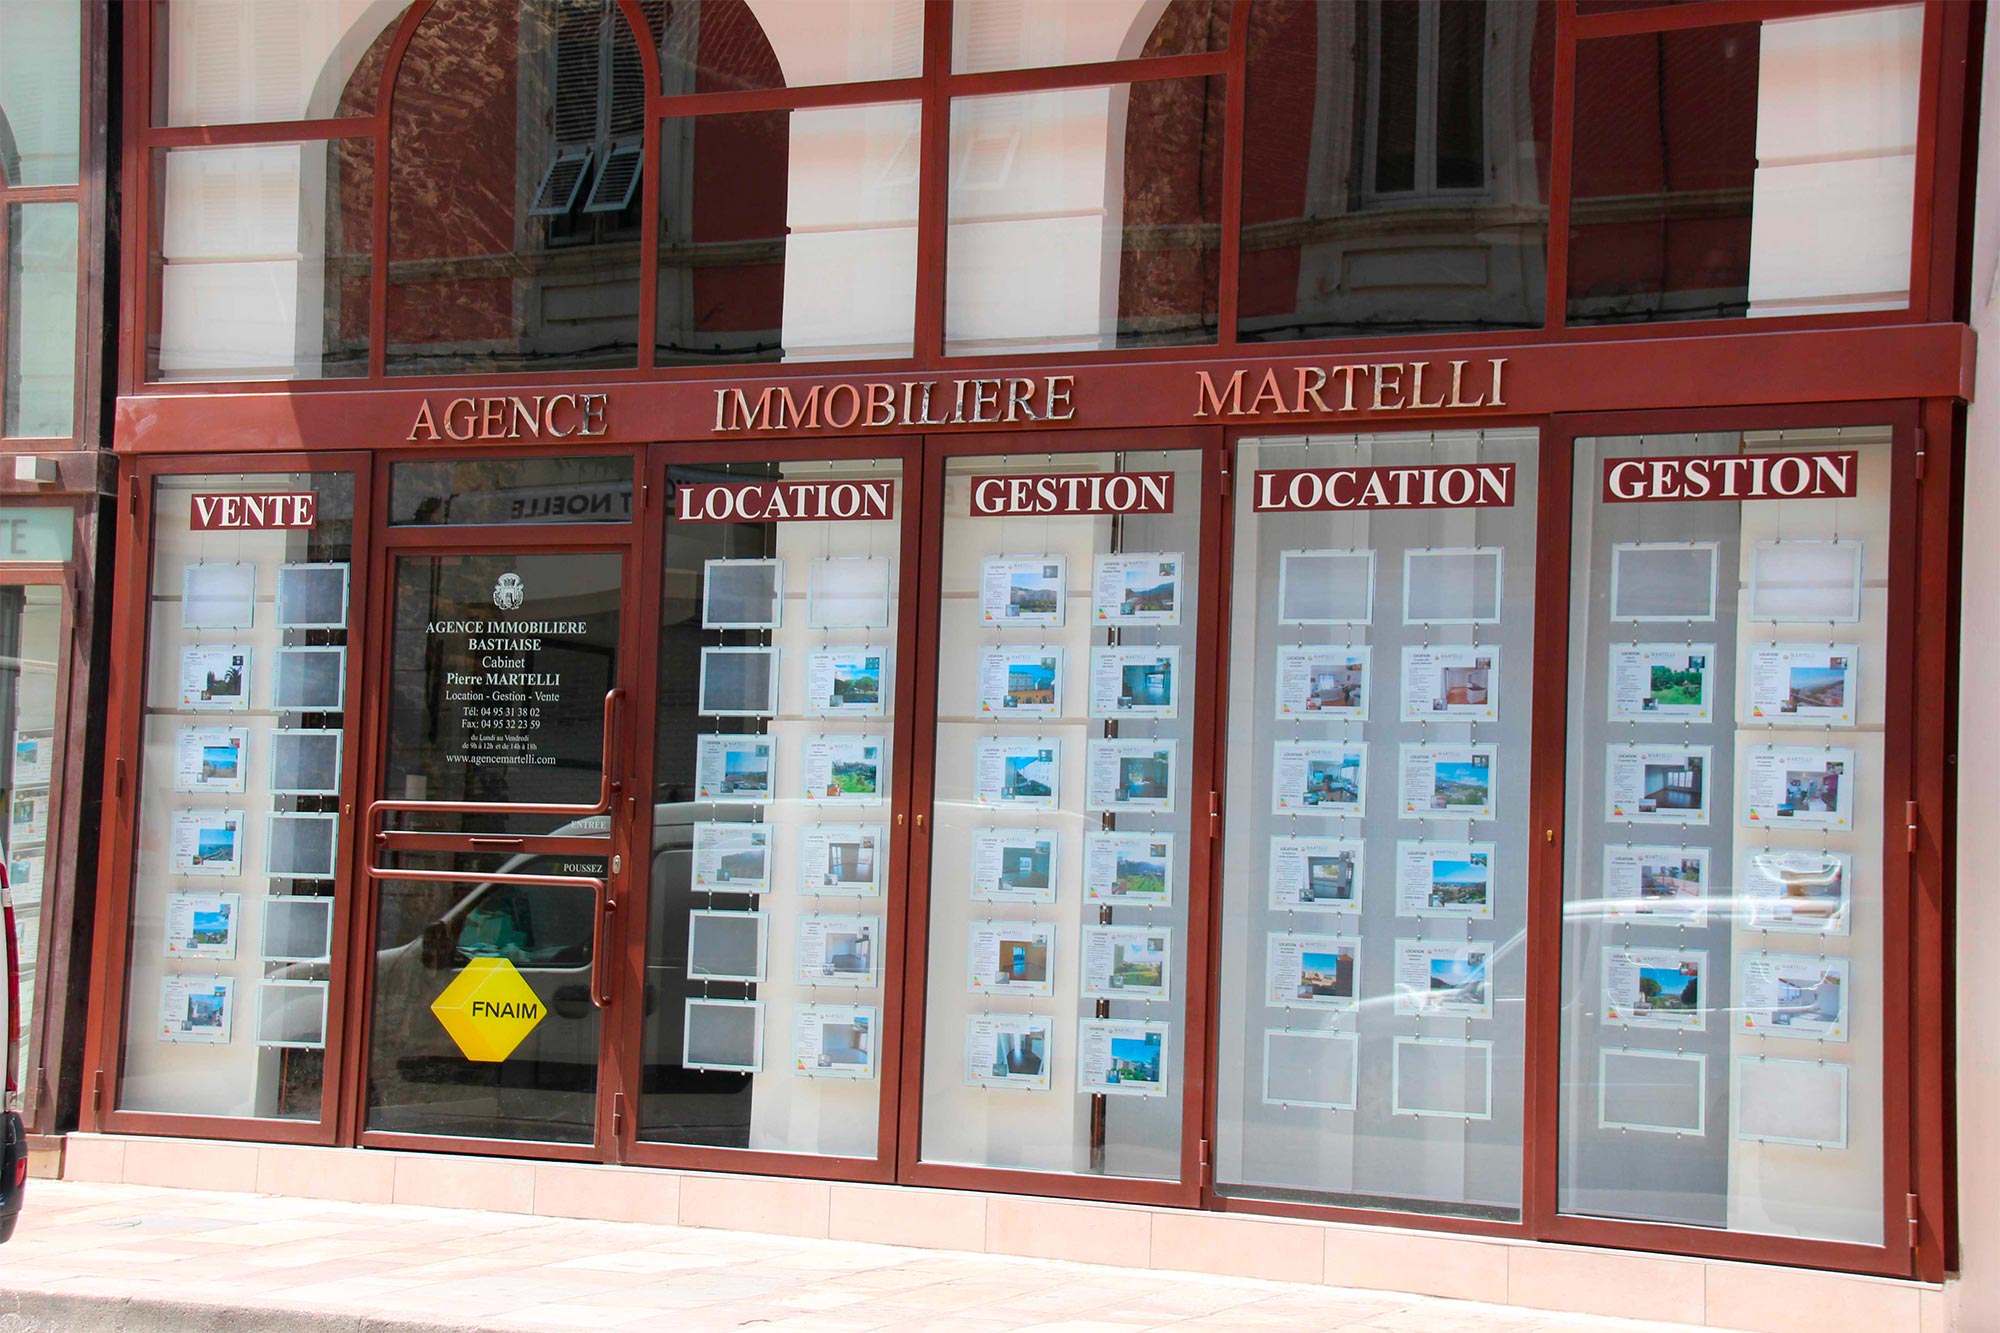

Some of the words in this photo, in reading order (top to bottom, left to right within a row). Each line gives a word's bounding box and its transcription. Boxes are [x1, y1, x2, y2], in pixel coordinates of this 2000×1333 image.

[406, 392, 608, 442] AGENCE
[711, 375, 1076, 432] IMMOBILIERE
[1193, 358, 1509, 417] MARTELLI
[1609, 455, 1852, 499] GESTION
[975, 475, 1170, 513] GESTION
[1257, 467, 1512, 509] LOCATION
[679, 483, 891, 520] LOCATION
[194, 494, 314, 527] VENTE
[426, 621, 484, 634] AGENCE
[487, 621, 587, 634] IMMOBILIERE
[468, 638, 542, 651] BASTIAISE
[482, 656, 525, 668] Cabinet
[446, 673, 482, 686] Pierre
[486, 673, 560, 686] MARTELLI
[446, 691, 484, 701] Location
[492, 691, 526, 701] Gestion
[534, 692, 560, 702] Vente
[481, 707, 491, 716] 04
[493, 707, 503, 716] 95
[505, 707, 514, 716] 31
[518, 708, 528, 716] 38
[530, 708, 540, 717] 02
[461, 719, 479, 728] Fax:
[481, 720, 491, 728] 04
[493, 720, 503, 728] 95
[505, 720, 515, 729] 32
[518, 720, 528, 729] 23
[530, 720, 541, 729] 59
[446, 754, 556, 766] www.agencemartelli.com
[564, 864, 603, 873] POUSSEZ
[472, 1001, 538, 1020] FNAIM
